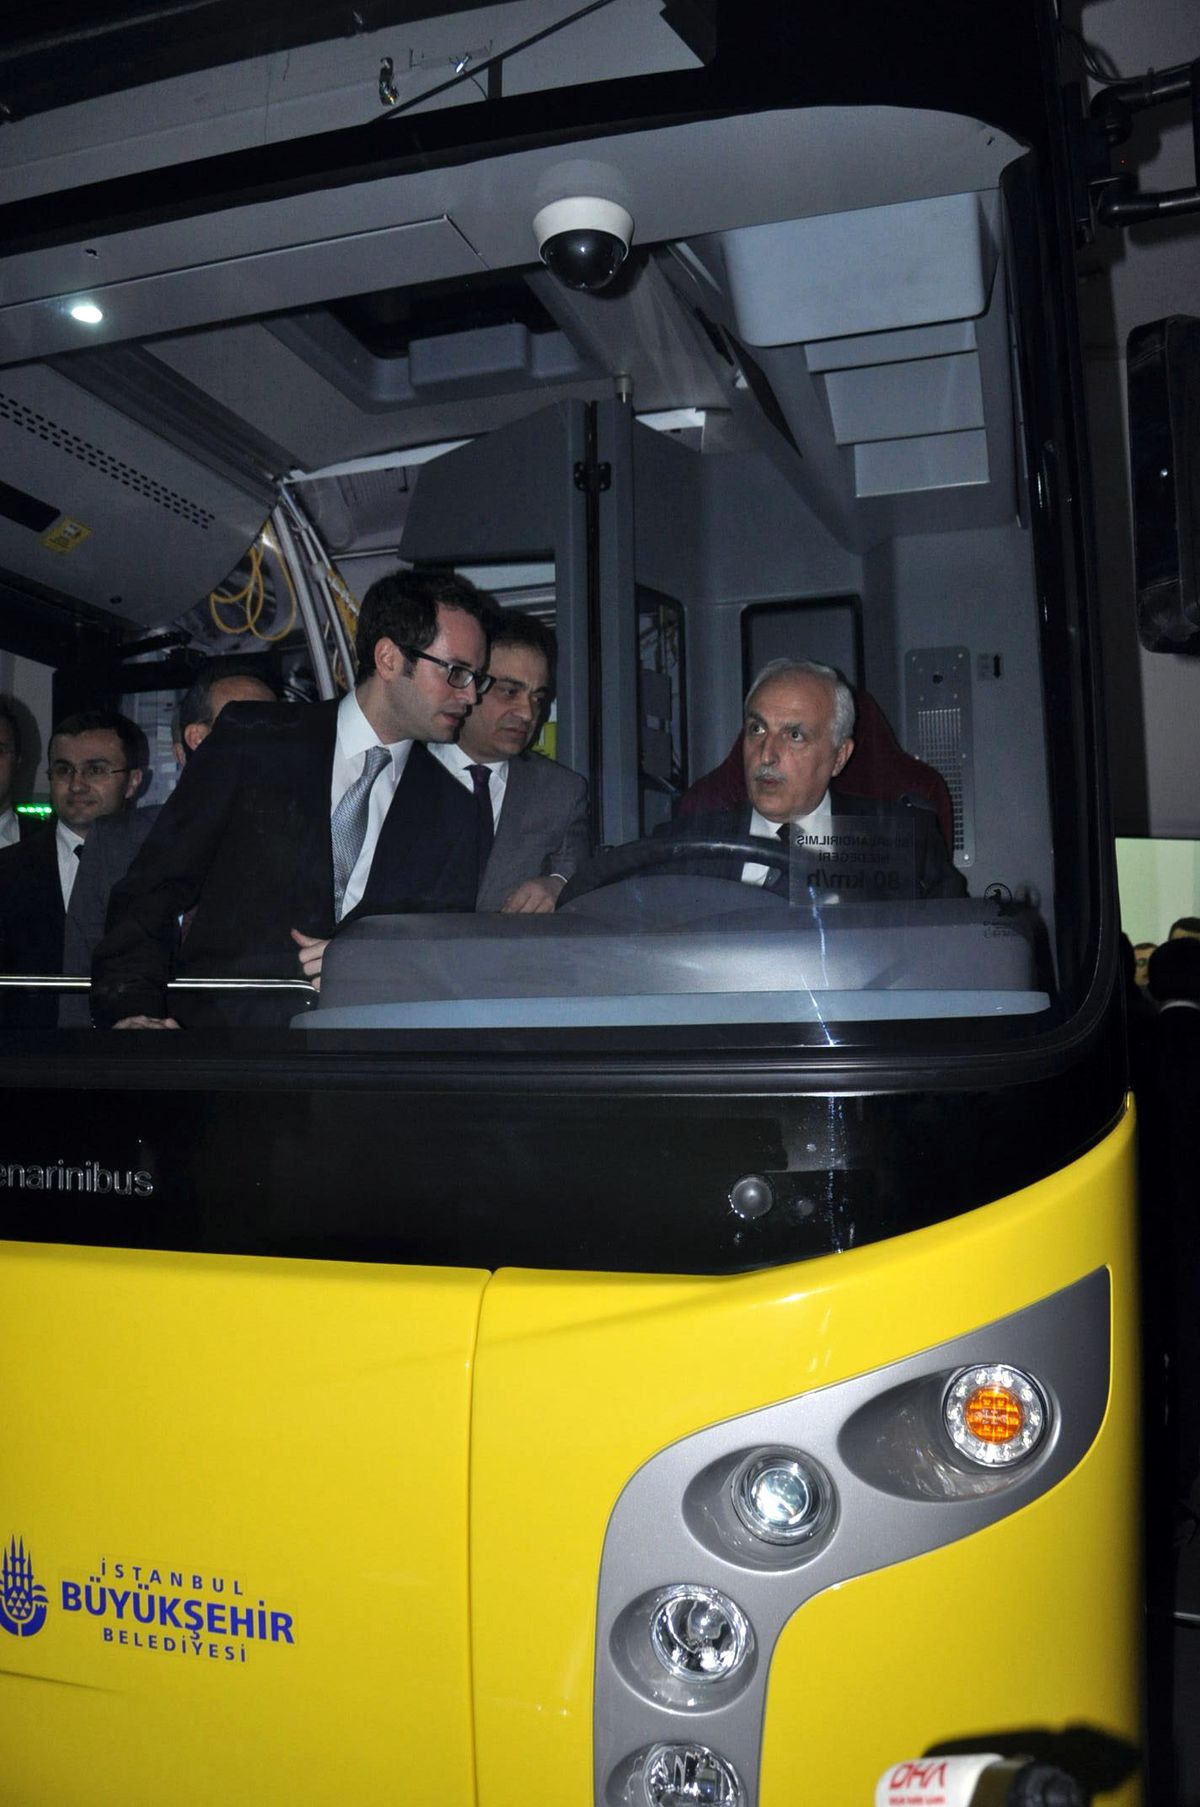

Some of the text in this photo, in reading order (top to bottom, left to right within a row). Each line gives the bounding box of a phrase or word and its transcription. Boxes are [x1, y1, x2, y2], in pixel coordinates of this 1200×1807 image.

[101, 1557, 243, 1596] İSTANBUL
[61, 1575, 295, 1644] BÜYÜKŞEHİR
[103, 1627, 246, 1662] BELEDİYESİ
